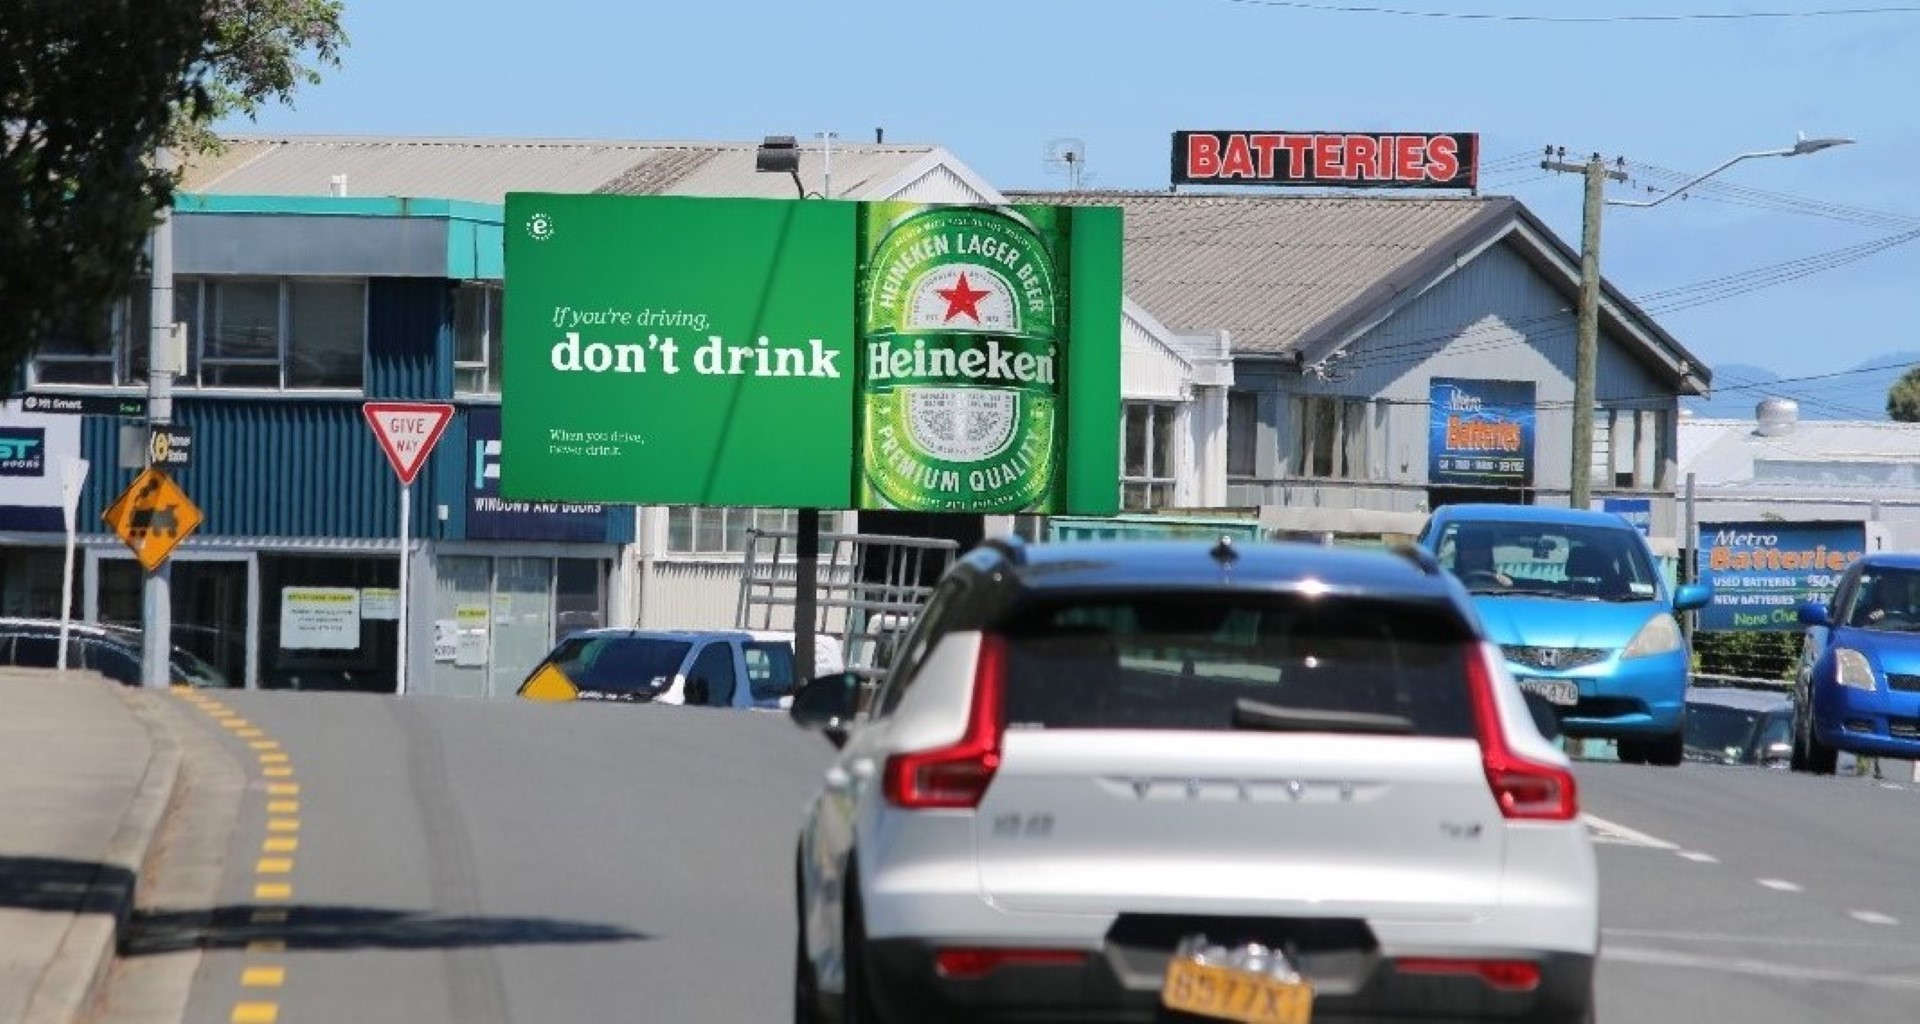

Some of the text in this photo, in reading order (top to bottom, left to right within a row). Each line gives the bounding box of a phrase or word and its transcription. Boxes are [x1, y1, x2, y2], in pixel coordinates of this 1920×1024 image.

[1187, 134, 1459, 182] BATTERIES
[880, 233, 950, 309] HEINEKEN
[957, 233, 1021, 270] LAGER
[1015, 263, 1045, 313] BEER
[552, 306, 711, 331] If you're driving,
[551, 332, 841, 378] don't drink
[868, 338, 1055, 385] Heineken
[390, 418, 425, 434] GIVE
[396, 439, 419, 452] WAY
[549, 429, 583, 442] When
[585, 432, 608, 444] you
[877, 425, 1039, 493] PREMIUM QUALITY
[1713, 530, 1778, 546] Metro
[1713, 575, 1740, 588] USED
[1742, 575, 1797, 588] BATTERIES
[1713, 593, 1739, 606] NEW
[1741, 593, 1796, 606] BATTERIES
[1733, 607, 1799, 627] None Che
